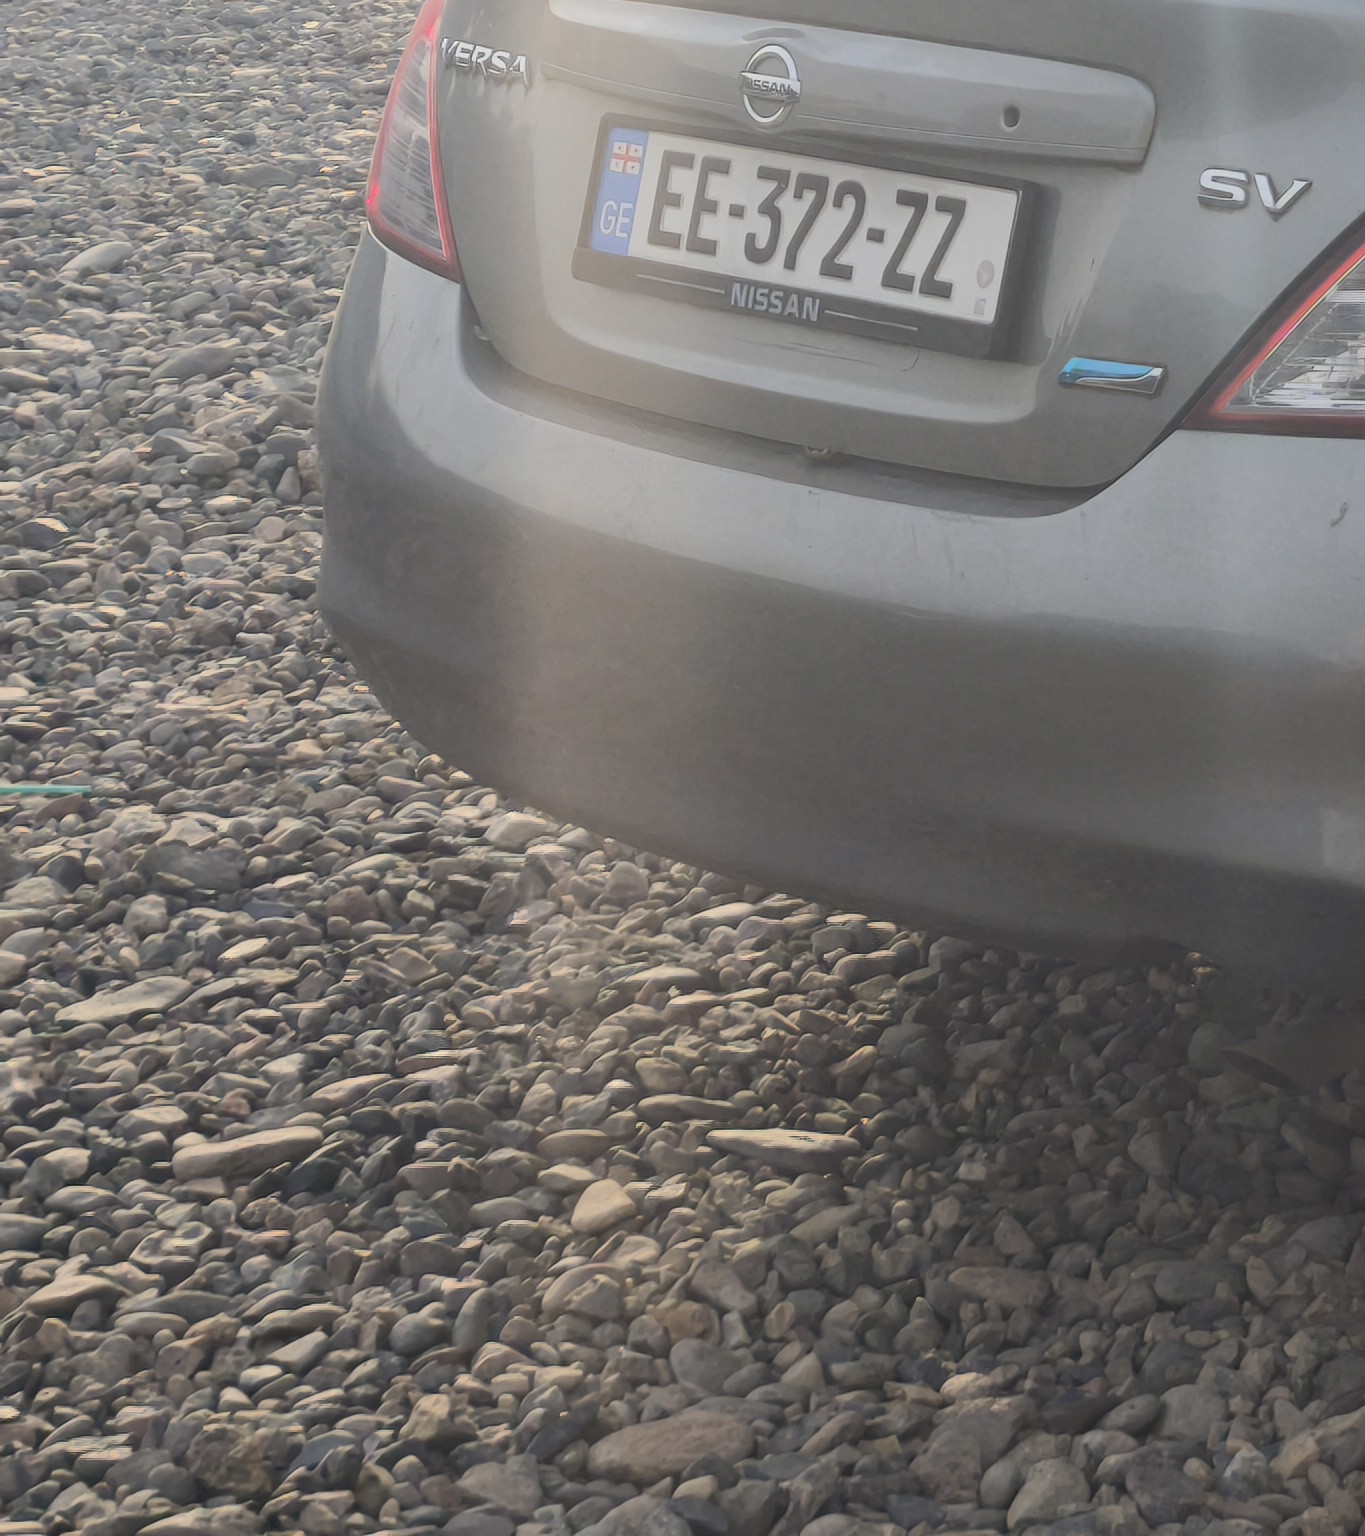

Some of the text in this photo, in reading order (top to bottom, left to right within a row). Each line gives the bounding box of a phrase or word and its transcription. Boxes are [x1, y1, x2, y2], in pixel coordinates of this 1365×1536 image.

[441, 37, 528, 84] VERSA
[1197, 167, 1313, 221] SV
[599, 200, 634, 240] GE
[646, 149, 968, 299] EE-372-ZZ
[730, 282, 821, 322] NISSAN
